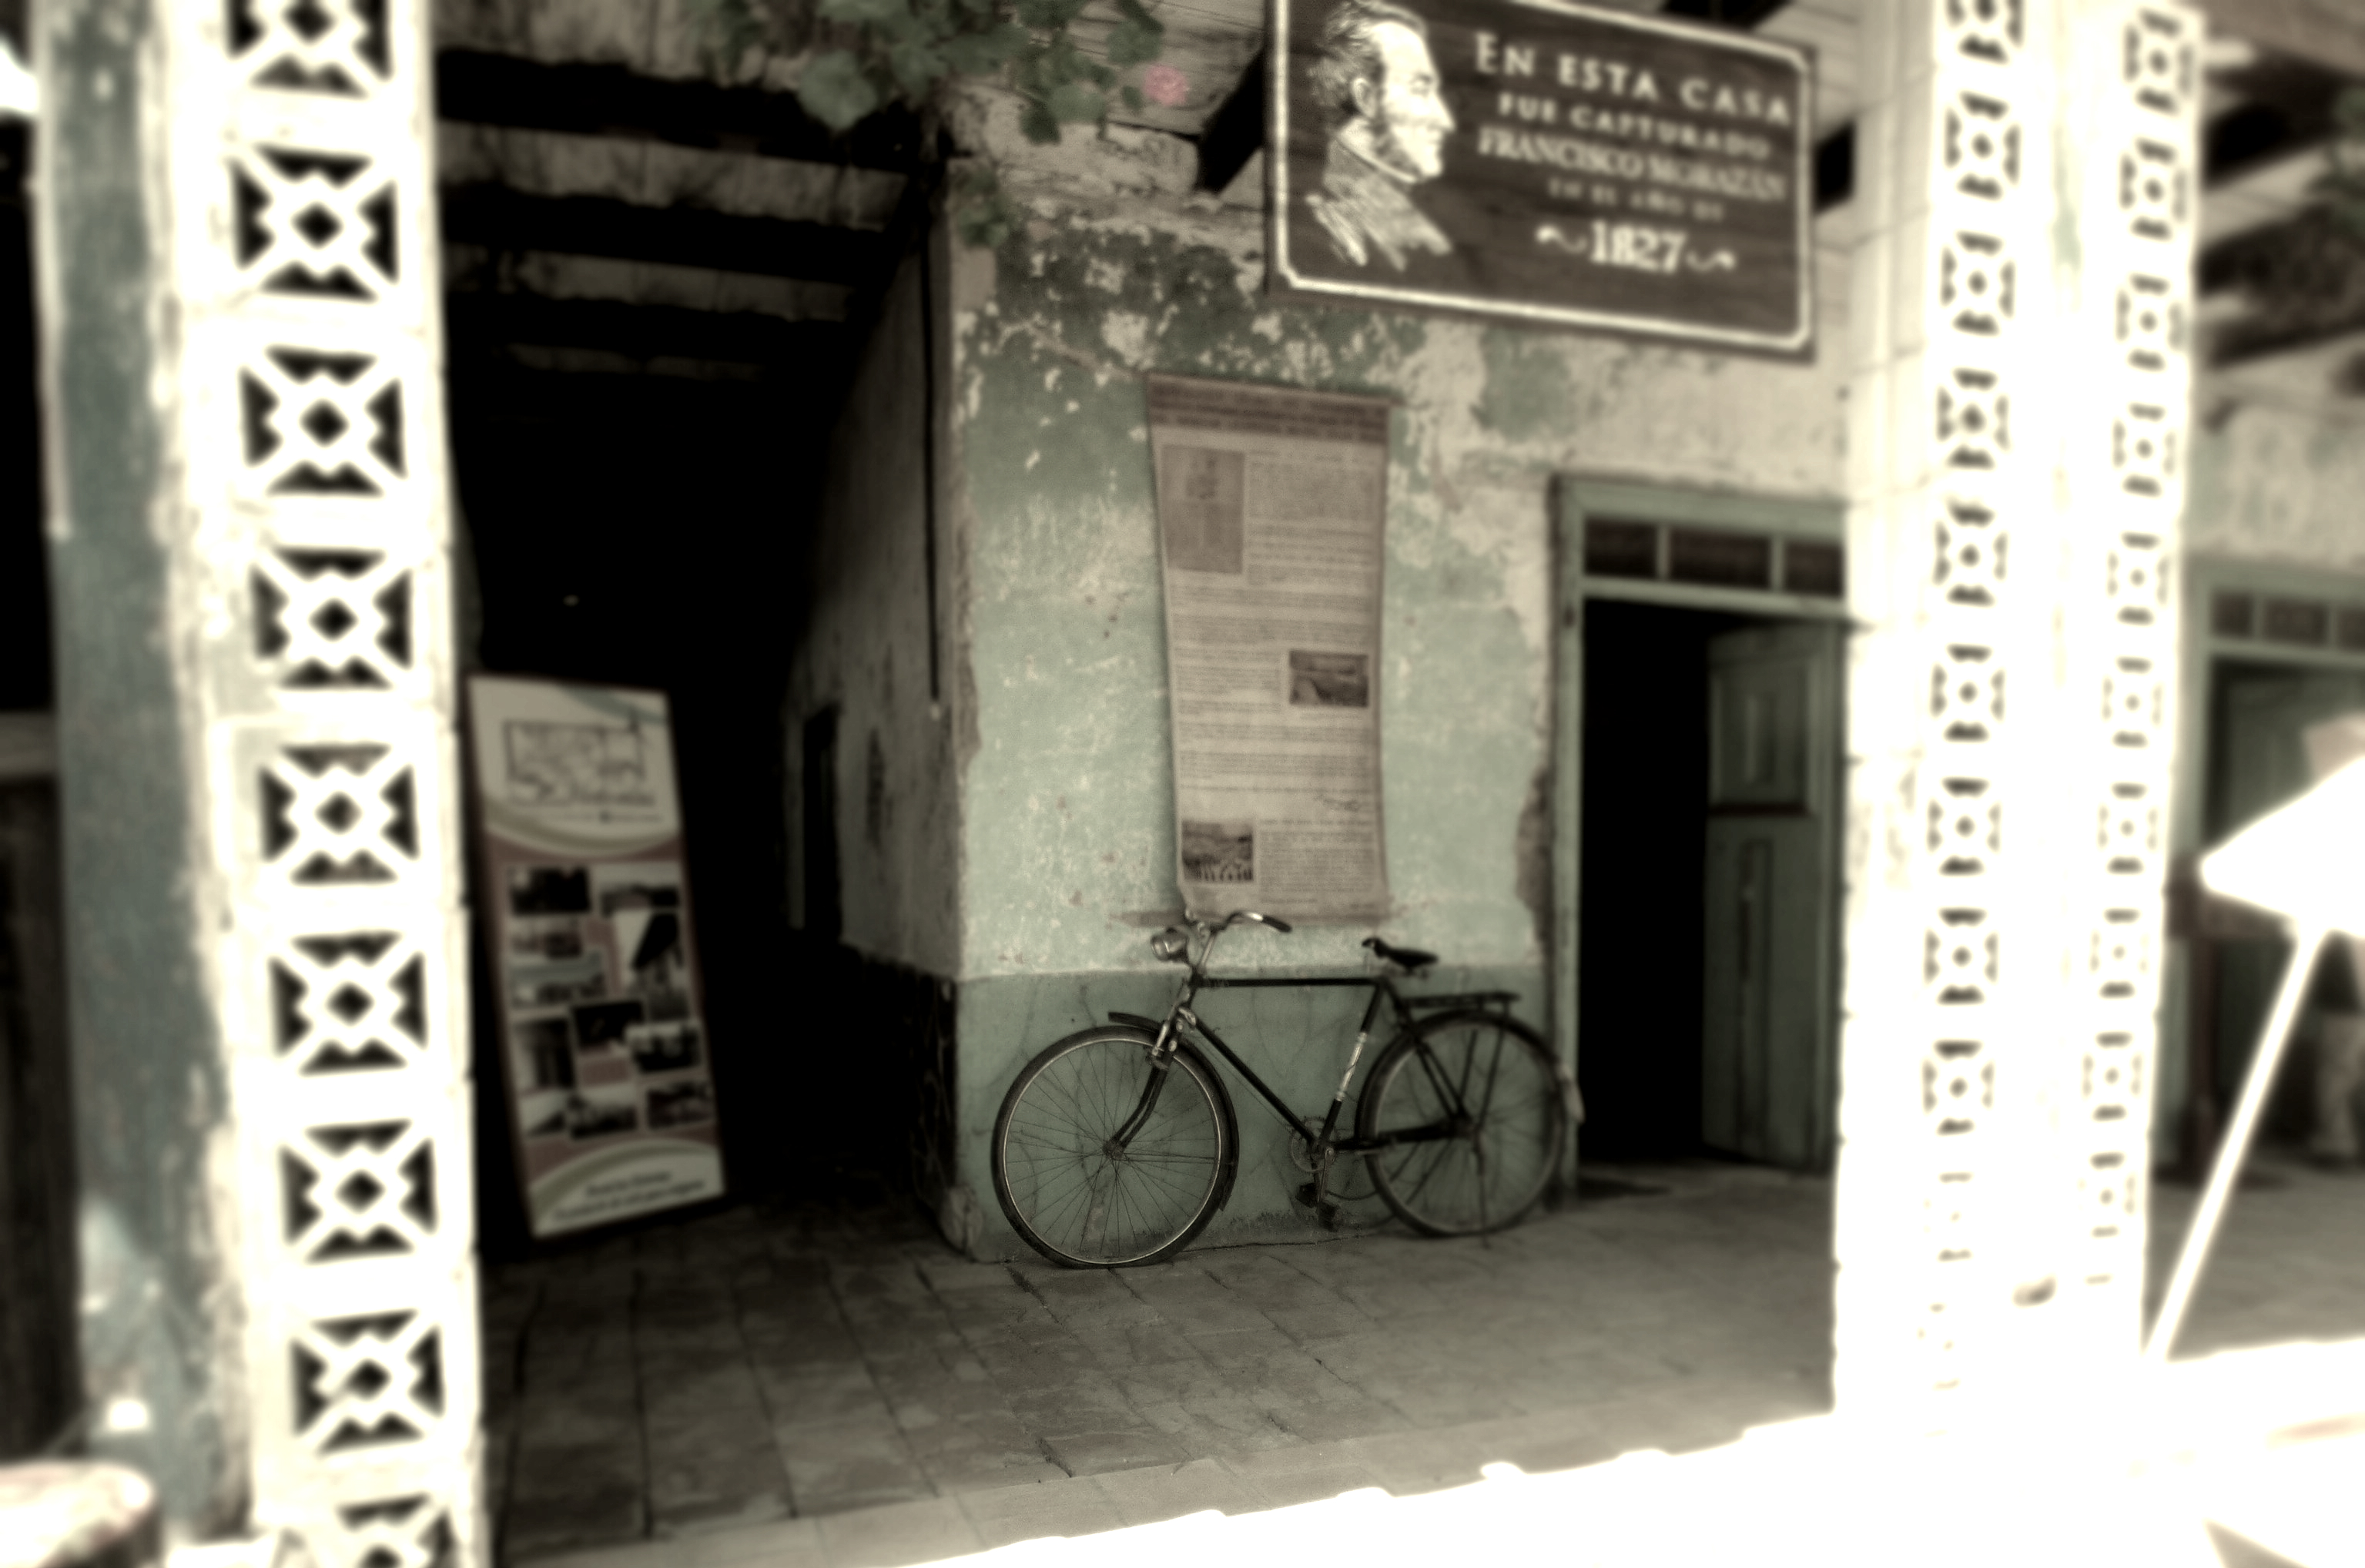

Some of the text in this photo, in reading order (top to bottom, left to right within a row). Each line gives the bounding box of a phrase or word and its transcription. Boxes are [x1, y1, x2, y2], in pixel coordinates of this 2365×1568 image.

[1476, 30, 1791, 126] EN ESTA CASA
[1478, 126, 1643, 178] FRANCISCO
[1499, 92, 1770, 159] FUE CAPTURADO
[1591, 219, 1688, 274] 1827
